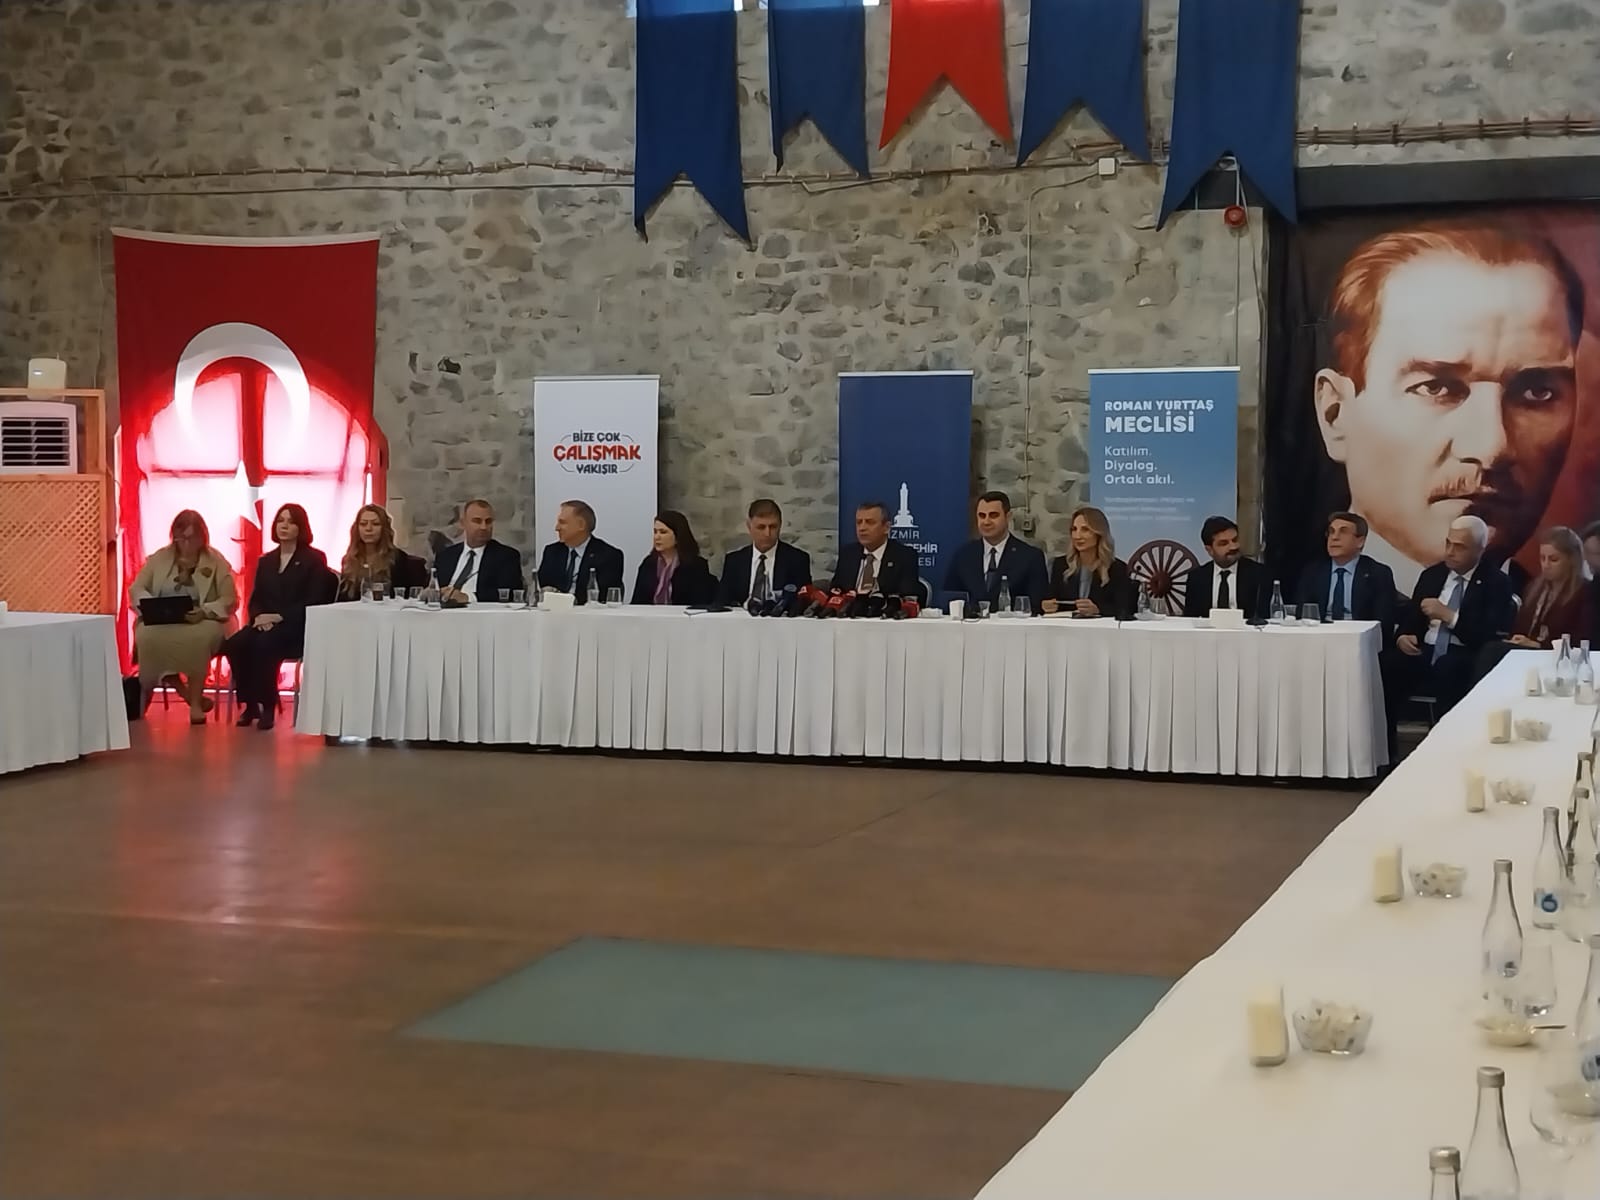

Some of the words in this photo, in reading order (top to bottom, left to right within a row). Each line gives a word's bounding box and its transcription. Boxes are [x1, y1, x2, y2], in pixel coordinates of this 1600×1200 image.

[1104, 401, 1152, 411] ROMAN
[1155, 399, 1214, 412] YURTTAŞ
[1105, 411, 1195, 433] MECLİSİ
[573, 429, 594, 442] BİZE
[597, 432, 621, 443] ÇOK
[553, 445, 641, 462] ÇALIŞMAK
[576, 463, 618, 475] YAKIŞIR
[1104, 460, 1157, 472] Diyalog.
[1104, 474, 1142, 485] Ortak
[1146, 474, 1175, 485] akıl.
[918, 556, 935, 567] ESİ
